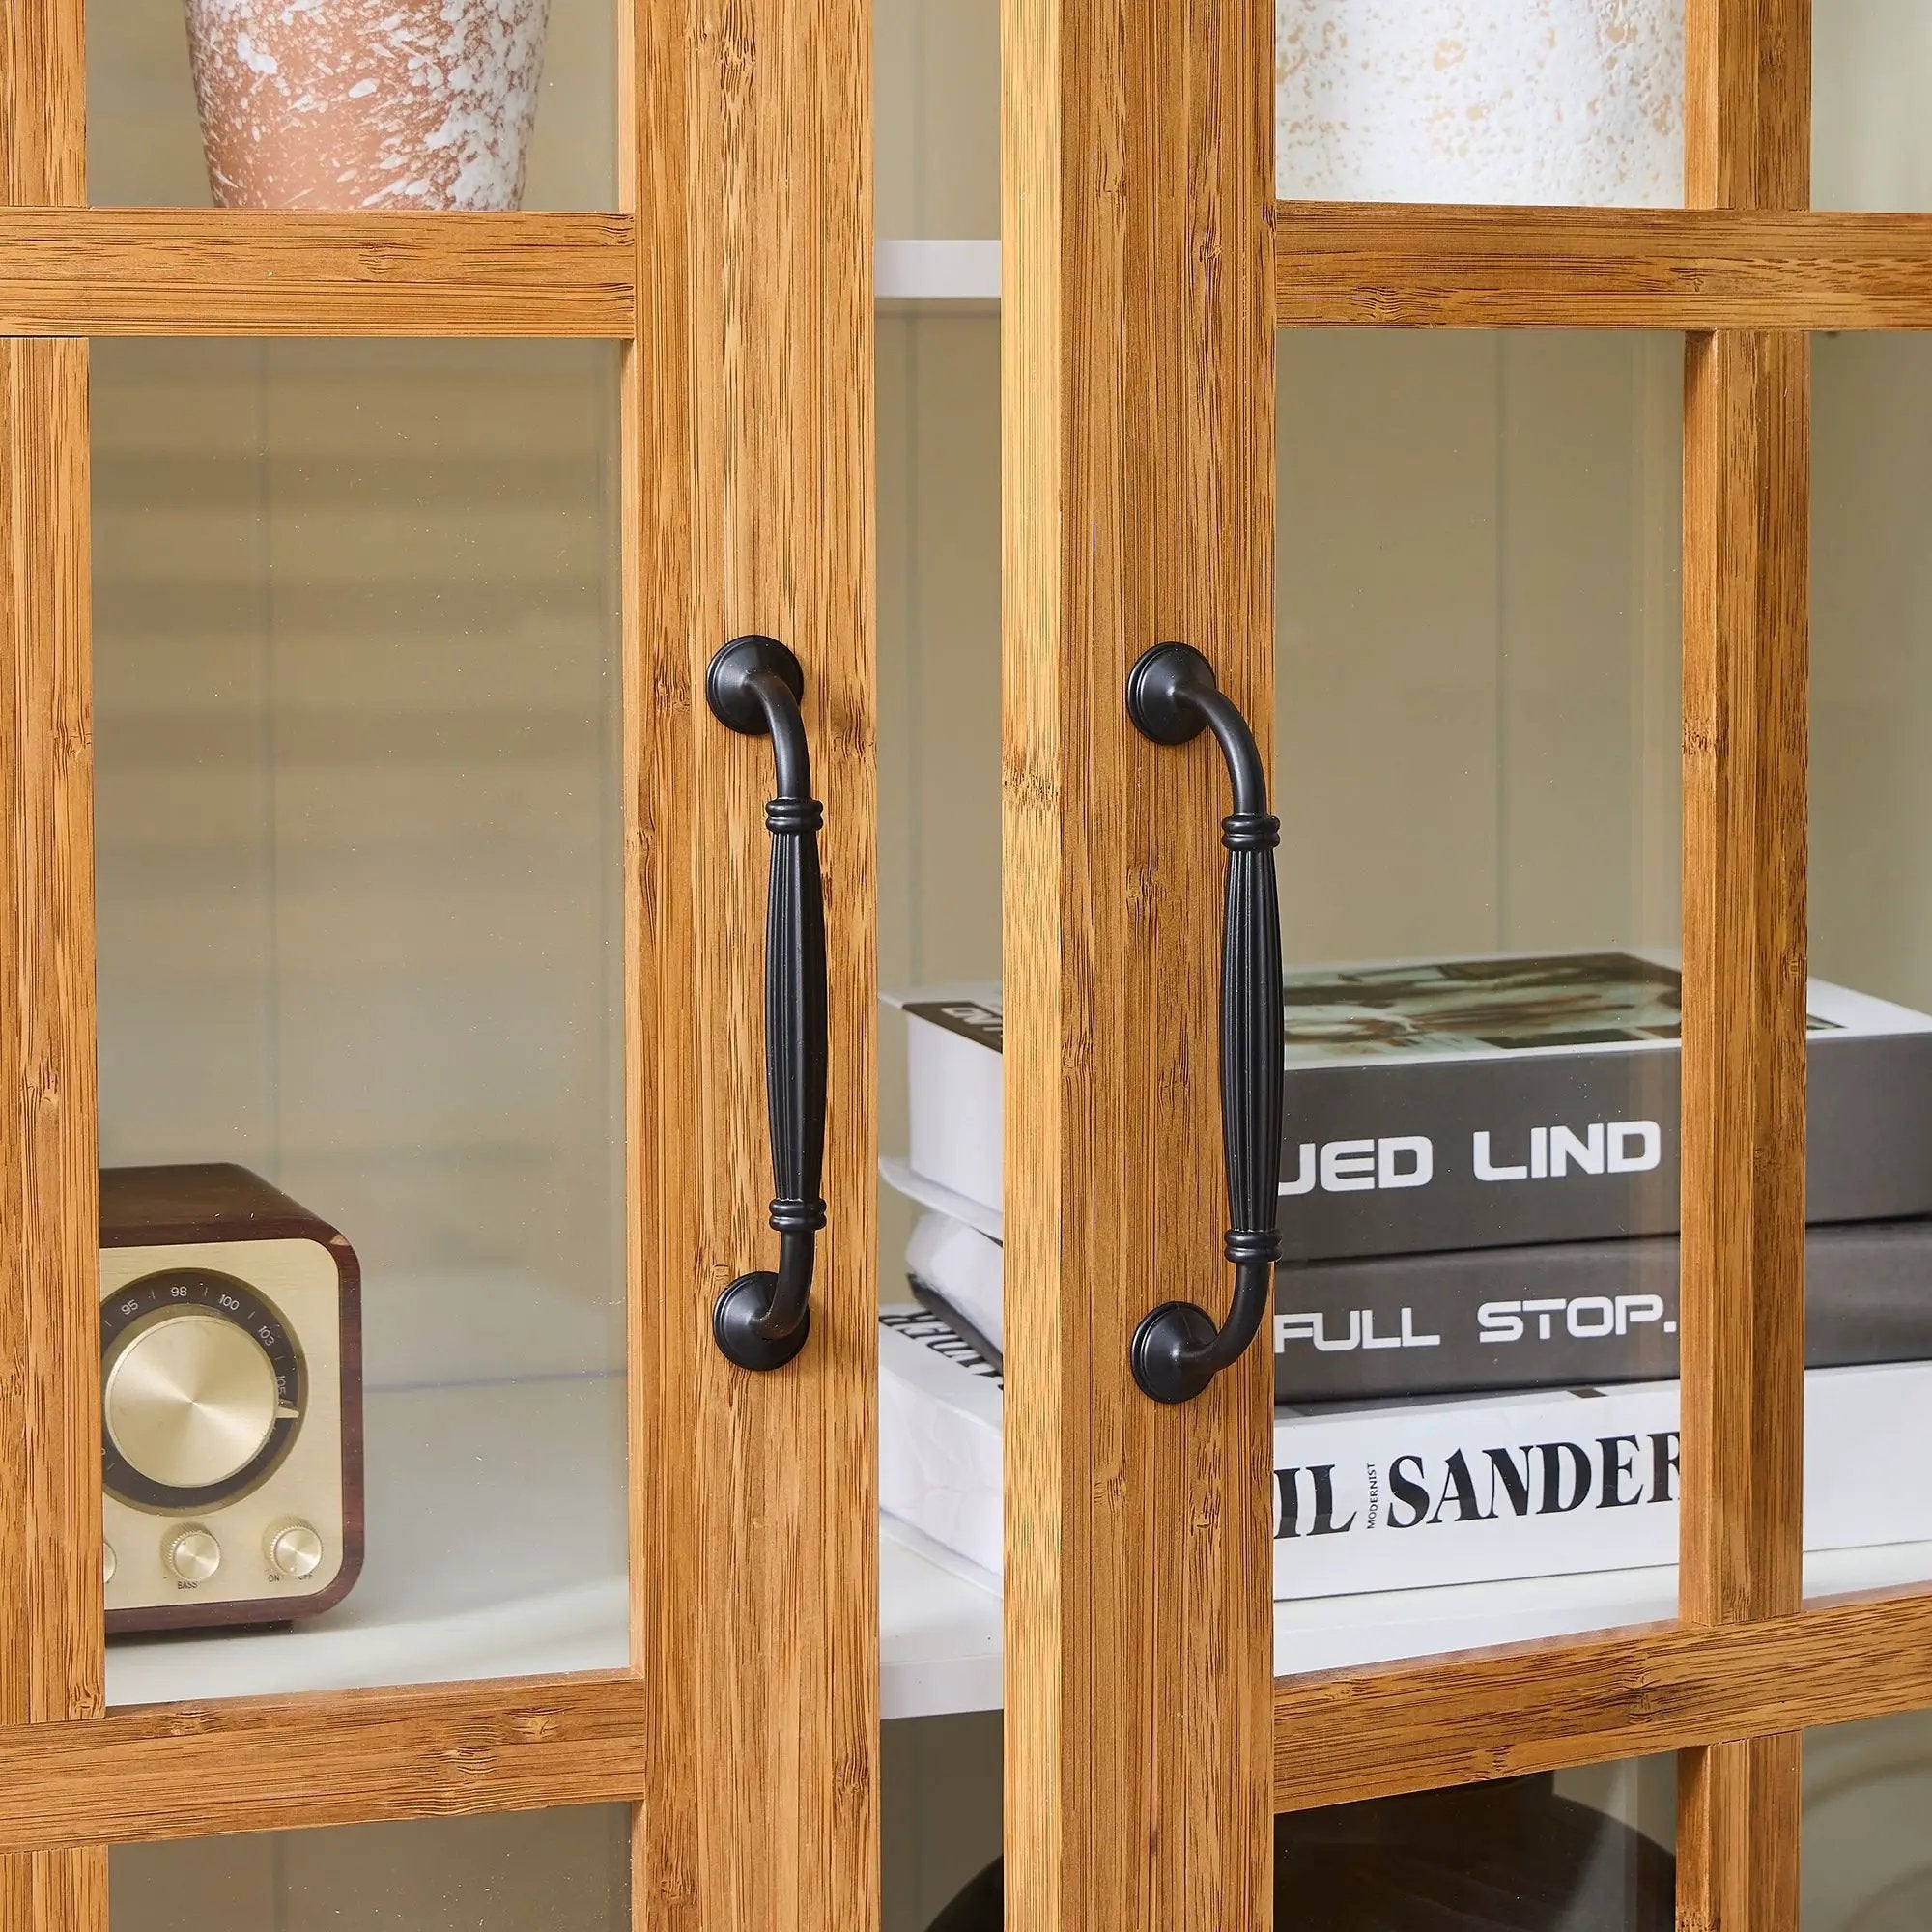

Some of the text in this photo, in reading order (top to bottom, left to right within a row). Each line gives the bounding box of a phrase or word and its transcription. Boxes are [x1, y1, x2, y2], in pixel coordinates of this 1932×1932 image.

[1473, 1120, 1662, 1181] LIND
[121, 1286, 287, 1396] 95 98 100 103 105
[1273, 1294, 1677, 1353] FULL STOP.
[1366, 1463, 1378, 1529] MODERNIST
[1386, 1432, 1680, 1528] SANDER
[177, 1580, 198, 1590] BASS
[269, 1574, 280, 1582] ON
